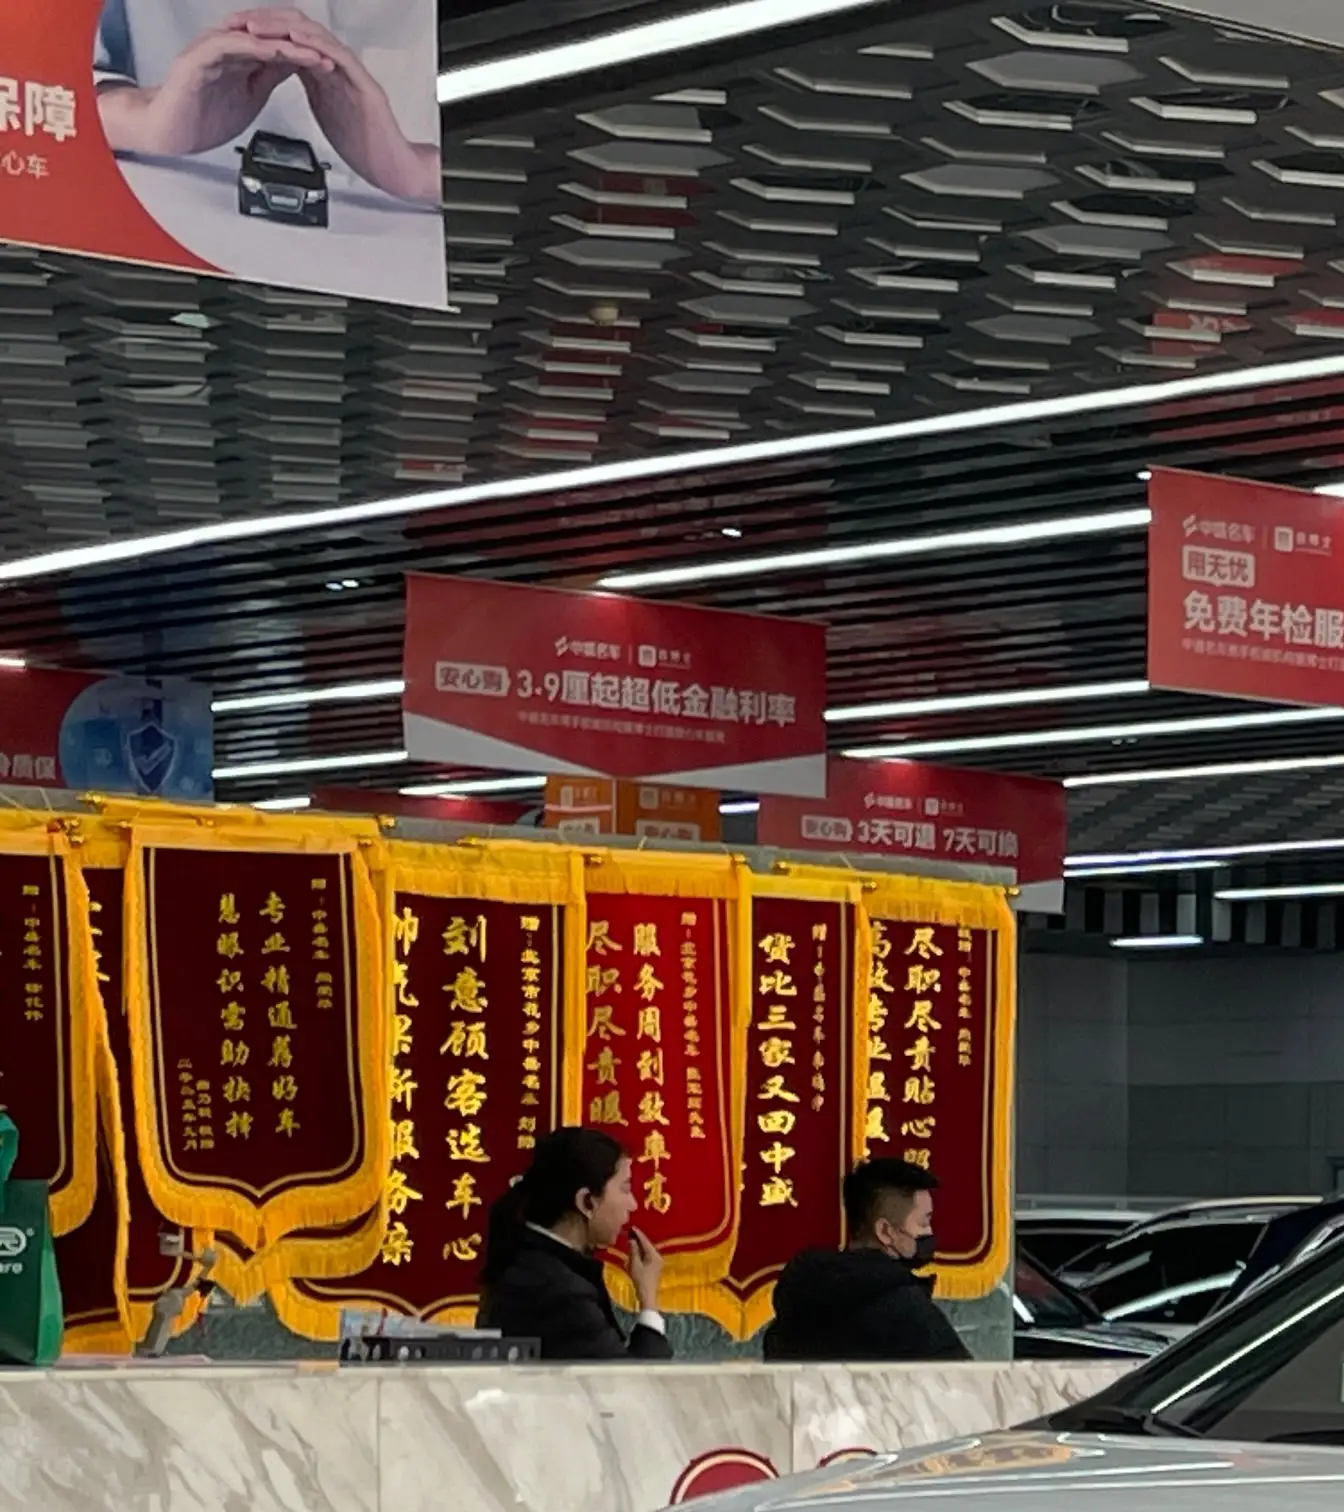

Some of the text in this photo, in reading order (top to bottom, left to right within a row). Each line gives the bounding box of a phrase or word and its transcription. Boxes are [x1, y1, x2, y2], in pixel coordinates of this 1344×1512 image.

[1186, 552, 1250, 583] 用无忧
[516, 669, 797, 727] 3.9厘起超低金融利率
[857, 818, 936, 851] 3天可退
[632, 921, 672, 1216] 服务周到效率高
